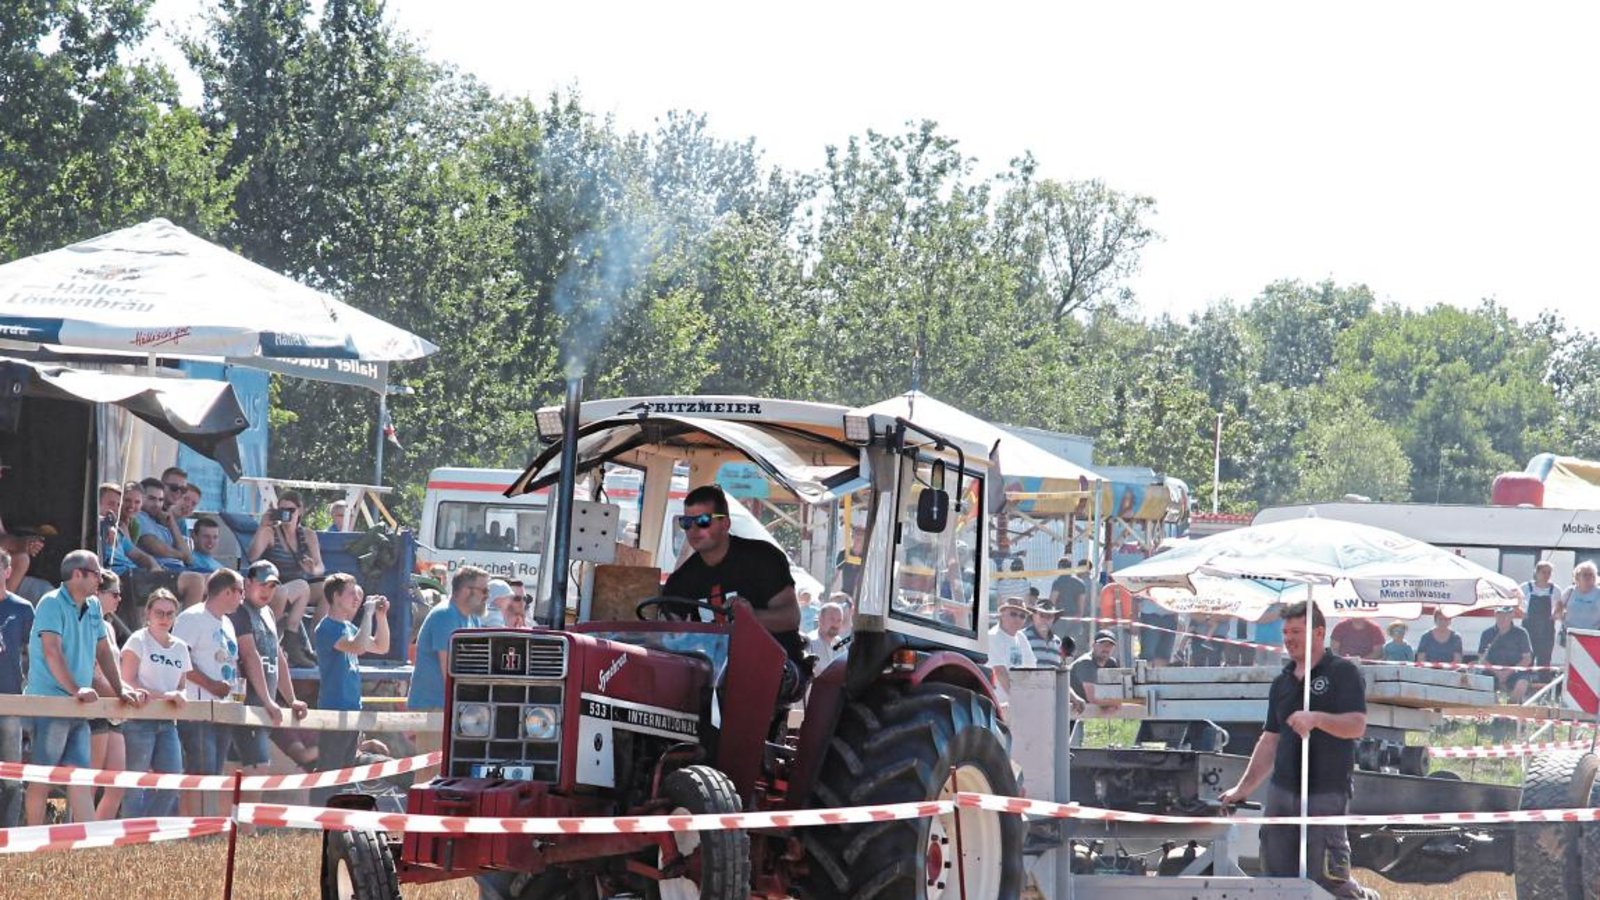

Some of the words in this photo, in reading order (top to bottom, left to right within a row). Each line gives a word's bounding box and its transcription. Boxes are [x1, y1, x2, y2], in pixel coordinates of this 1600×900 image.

[53, 282, 136, 296] Haller
[6, 292, 155, 312] Löwenbräu
[1562, 523, 1594, 533] Mobile
[519, 563, 538, 576] Ro
[1381, 579, 1400, 588] Das
[1380, 589, 1450, 599] Mineralwasser
[589, 702, 607, 717] 533
